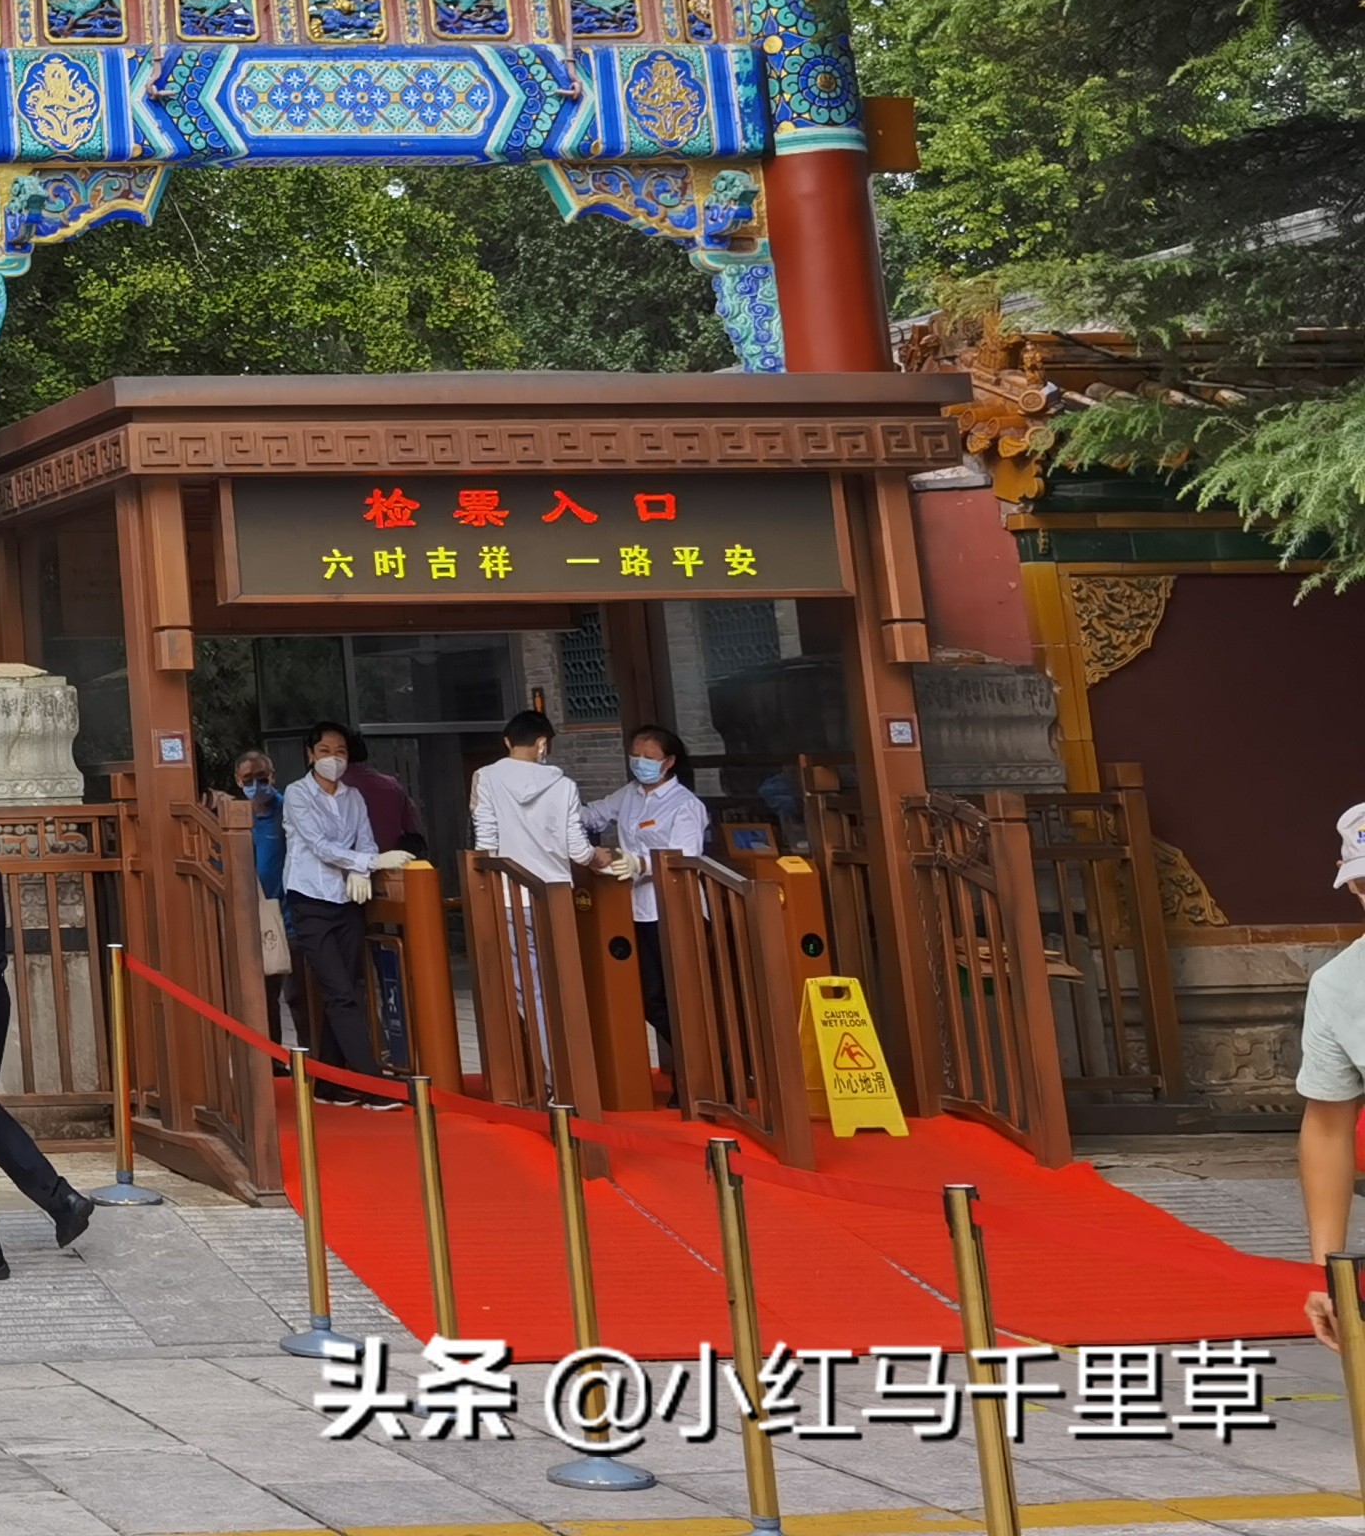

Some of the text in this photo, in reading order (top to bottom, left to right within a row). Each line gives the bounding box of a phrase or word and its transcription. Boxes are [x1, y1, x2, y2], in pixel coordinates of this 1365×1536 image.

[363, 487, 677, 530] 检票入口
[322, 543, 757, 580] 六时吉祥 一路平安
[821, 1019, 868, 1027] WET FLOOR
[824, 1010, 860, 1019] CAUTION
[833, 1071, 887, 1095] 小心地滑
